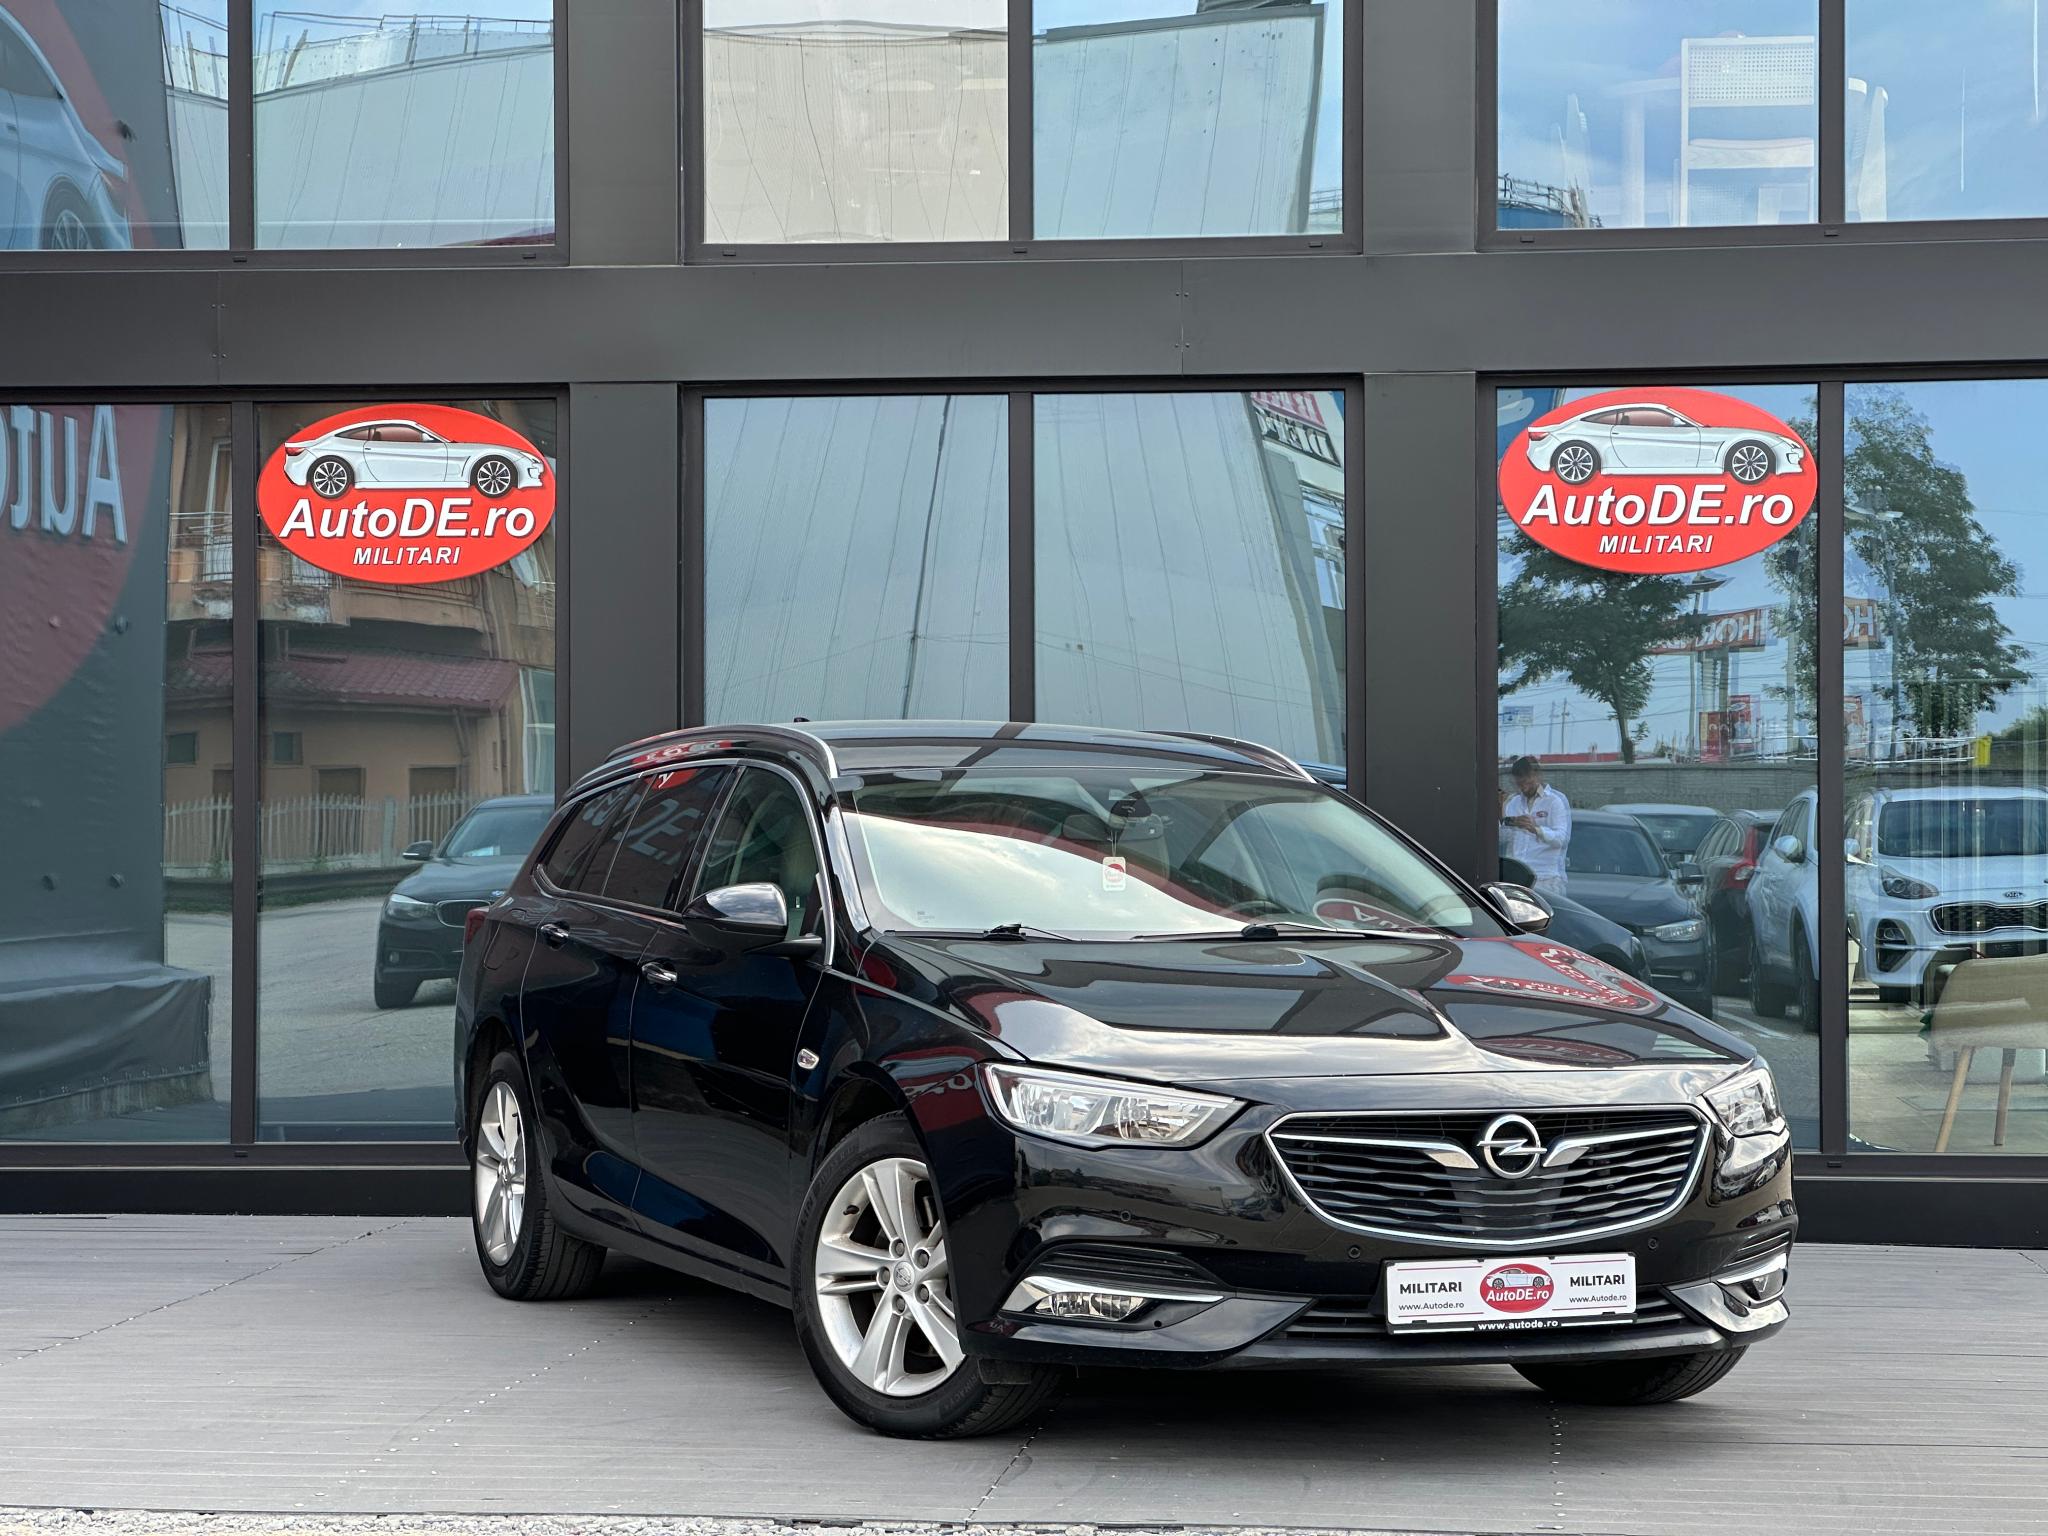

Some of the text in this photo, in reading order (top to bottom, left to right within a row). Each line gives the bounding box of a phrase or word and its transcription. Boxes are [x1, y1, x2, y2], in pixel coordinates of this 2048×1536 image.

[1521, 484, 1794, 525] AutoDE.ro
[278, 497, 535, 538] AutoDE.ro
[1599, 535, 1713, 553] MILITARI
[353, 547, 460, 565] MILITARI
[1570, 1274, 1625, 1287] MILITARI
[1400, 1282, 1462, 1294] MILITARI
[1486, 1289, 1550, 1302] AutoDE.ro
[1569, 1294, 1627, 1304] www.Autode.ro
[1398, 1301, 1465, 1311] www.Autode.ro
[1478, 1320, 1559, 1330] www.autode.ro
